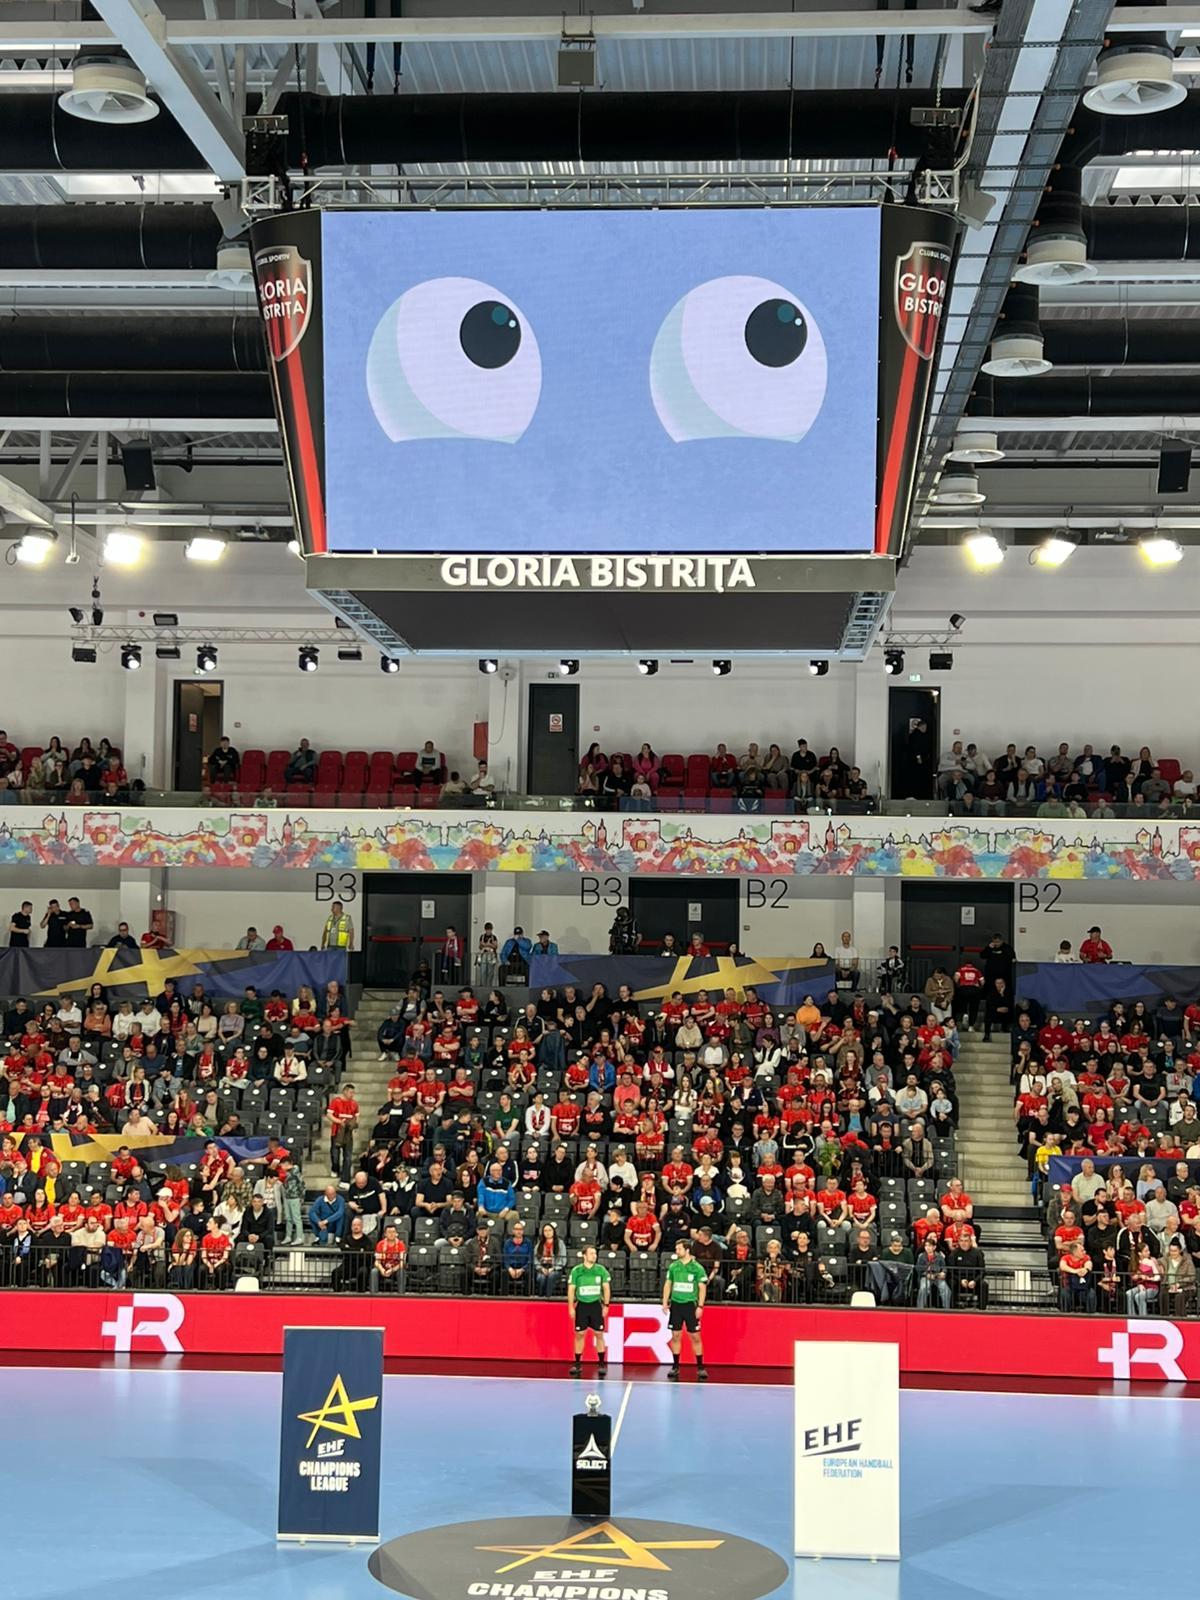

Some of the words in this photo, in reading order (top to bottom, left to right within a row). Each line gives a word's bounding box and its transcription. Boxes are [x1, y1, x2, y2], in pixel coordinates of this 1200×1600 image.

[259, 277, 306, 302] LORIA
[440, 556, 580, 587] GLORIA
[315, 872, 357, 902] B3
[581, 876, 623, 907] B3
[746, 878, 790, 909] B2
[1019, 882, 1064, 913] B2
[804, 1418, 862, 1450] EHF
[318, 1439, 345, 1455] EHF
[299, 1461, 361, 1477] CHAMPIONS
[576, 1459, 608, 1470] SELECT
[823, 1458, 858, 1467] EUROPEAN
[859, 1459, 893, 1469] HANDBALL
[823, 1468, 862, 1478] FEDERATION
[310, 1476, 349, 1491] LEAGUE
[532, 1569, 619, 1580] EHF
[467, 1582, 669, 1600] CHAMPIONS
